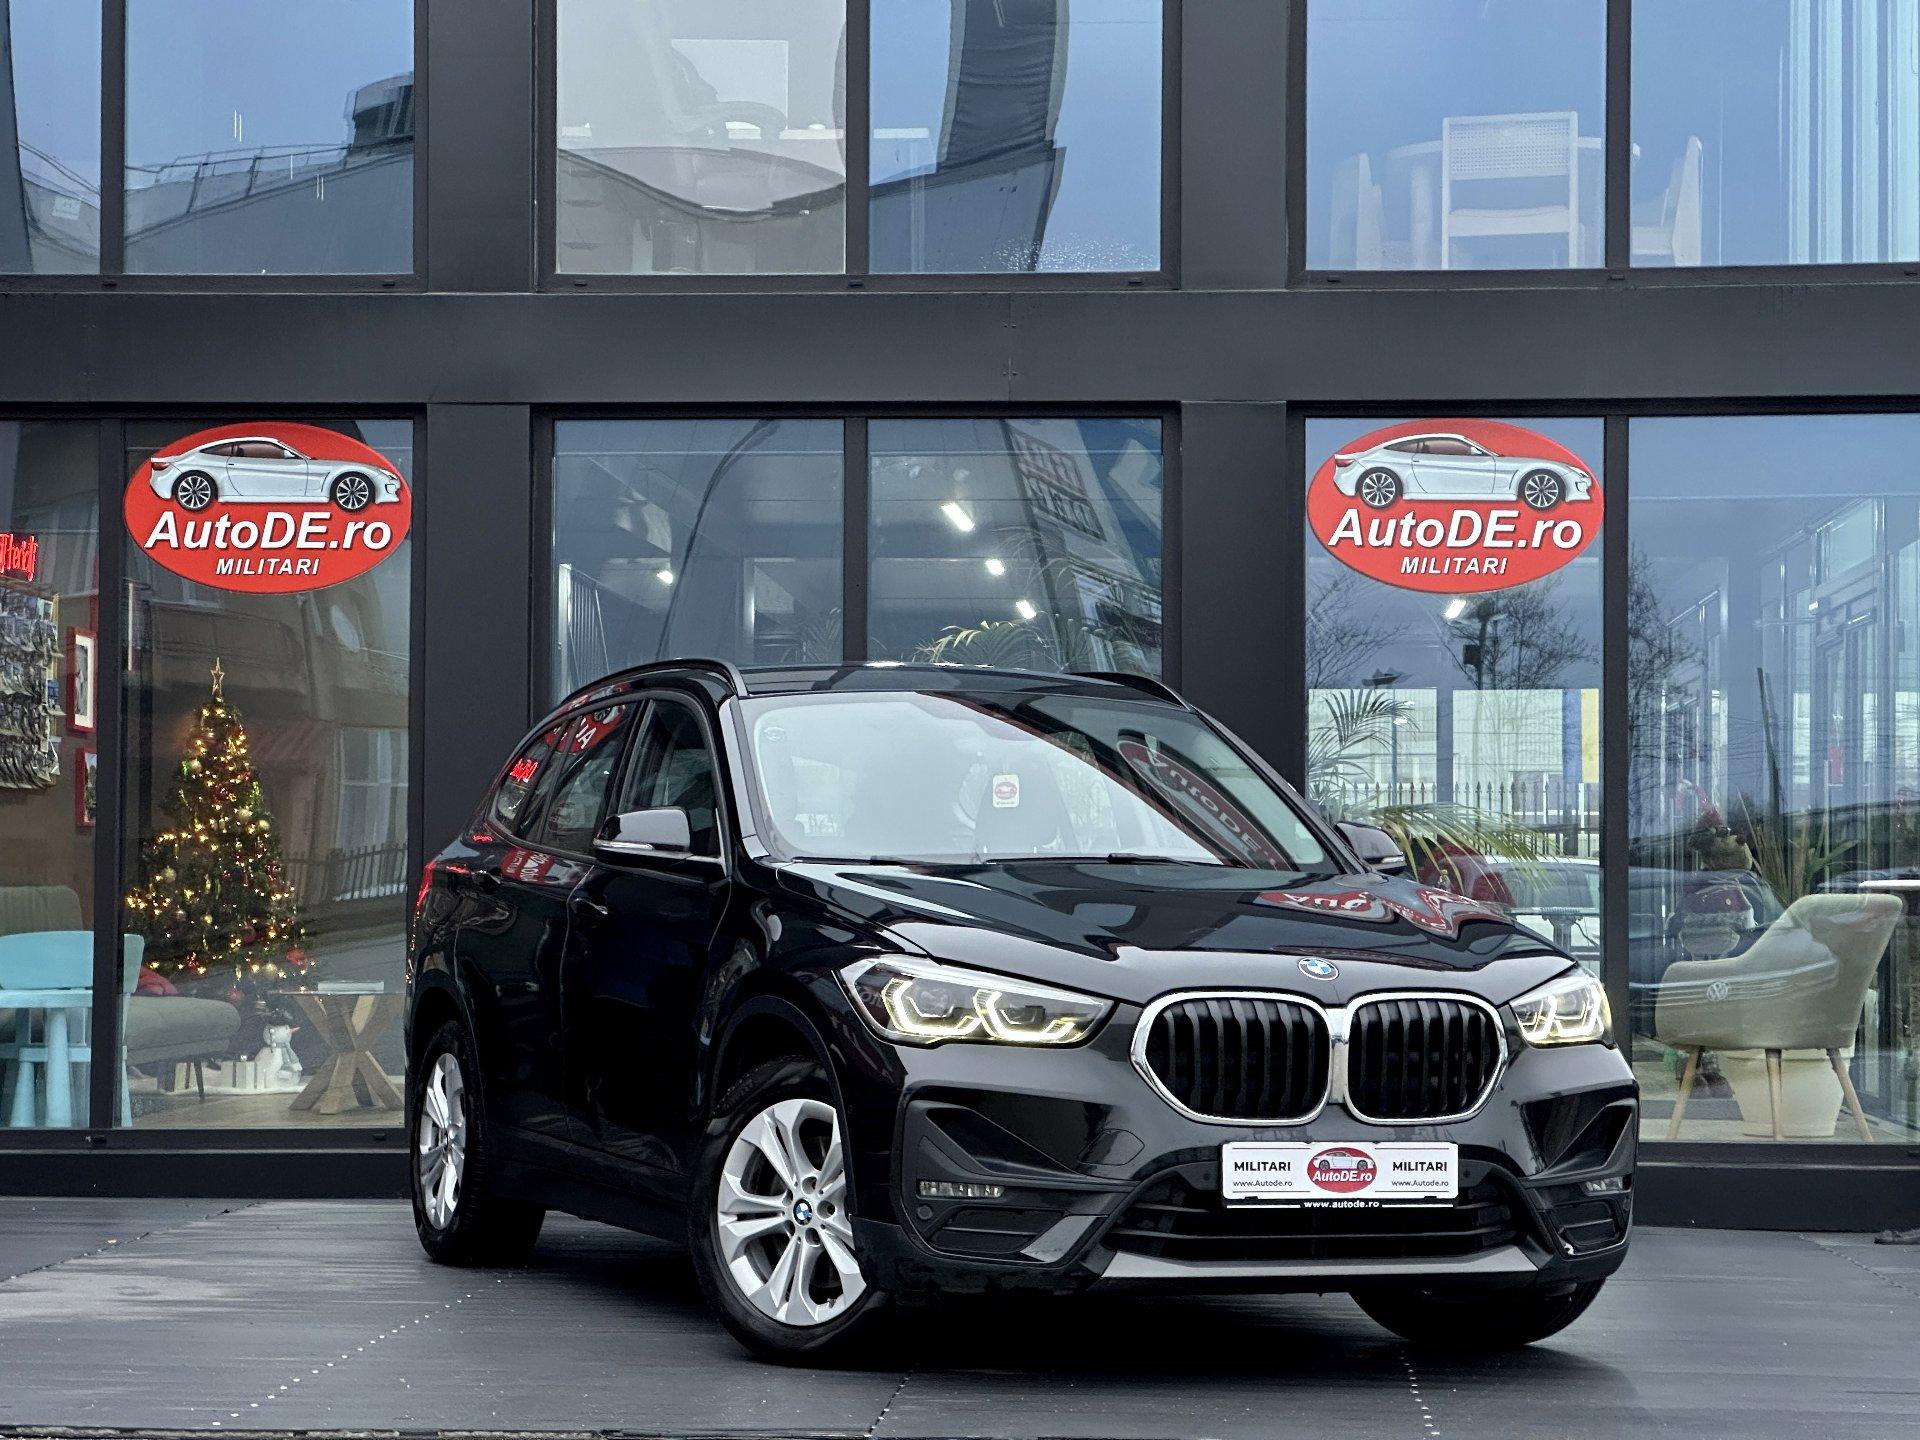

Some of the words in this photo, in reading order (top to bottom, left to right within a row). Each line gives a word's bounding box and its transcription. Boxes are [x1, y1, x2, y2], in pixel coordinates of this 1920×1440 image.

[144, 510, 392, 550] AutoDE.ro
[1328, 508, 1583, 549] AutoDE.ro
[216, 558, 320, 575] MILITARI
[1400, 556, 1508, 575] MILITARI
[1234, 1161, 1291, 1172] MILITARI
[1392, 1161, 1448, 1172] MILITARI
[1312, 1170, 1373, 1182] AutoDE.ro
[1303, 1200, 1380, 1208] www.autode.ro
